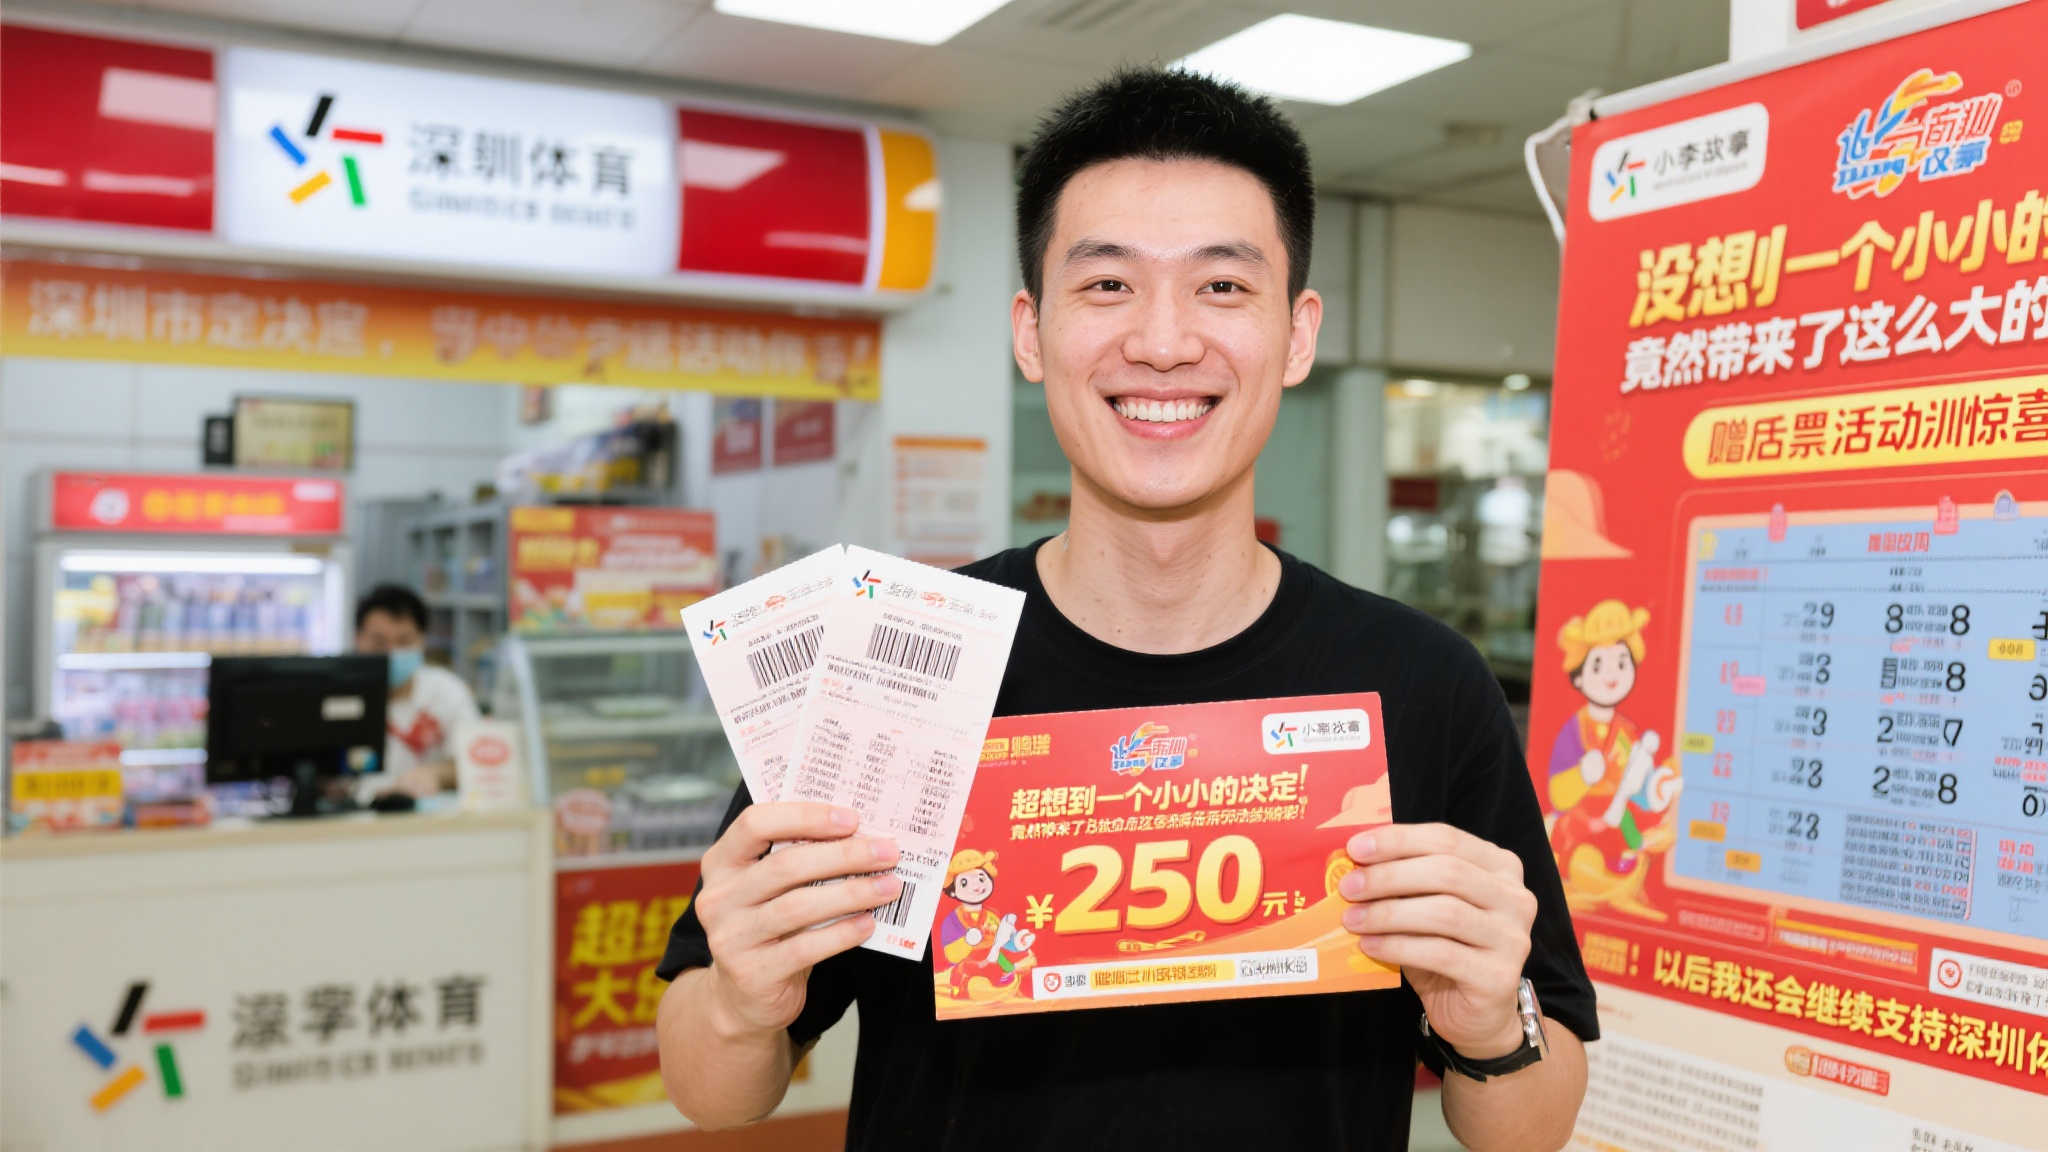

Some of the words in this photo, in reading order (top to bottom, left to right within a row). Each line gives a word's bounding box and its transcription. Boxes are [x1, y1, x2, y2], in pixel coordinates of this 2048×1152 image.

[1620, 276, 2048, 393] 竟然带来了这么大的
[1950, 604, 1970, 636] 8
[1946, 661, 1966, 692] 8
[1876, 716, 1894, 743] 2
[1872, 765, 1890, 794] 2
[1938, 773, 1957, 804] 8
